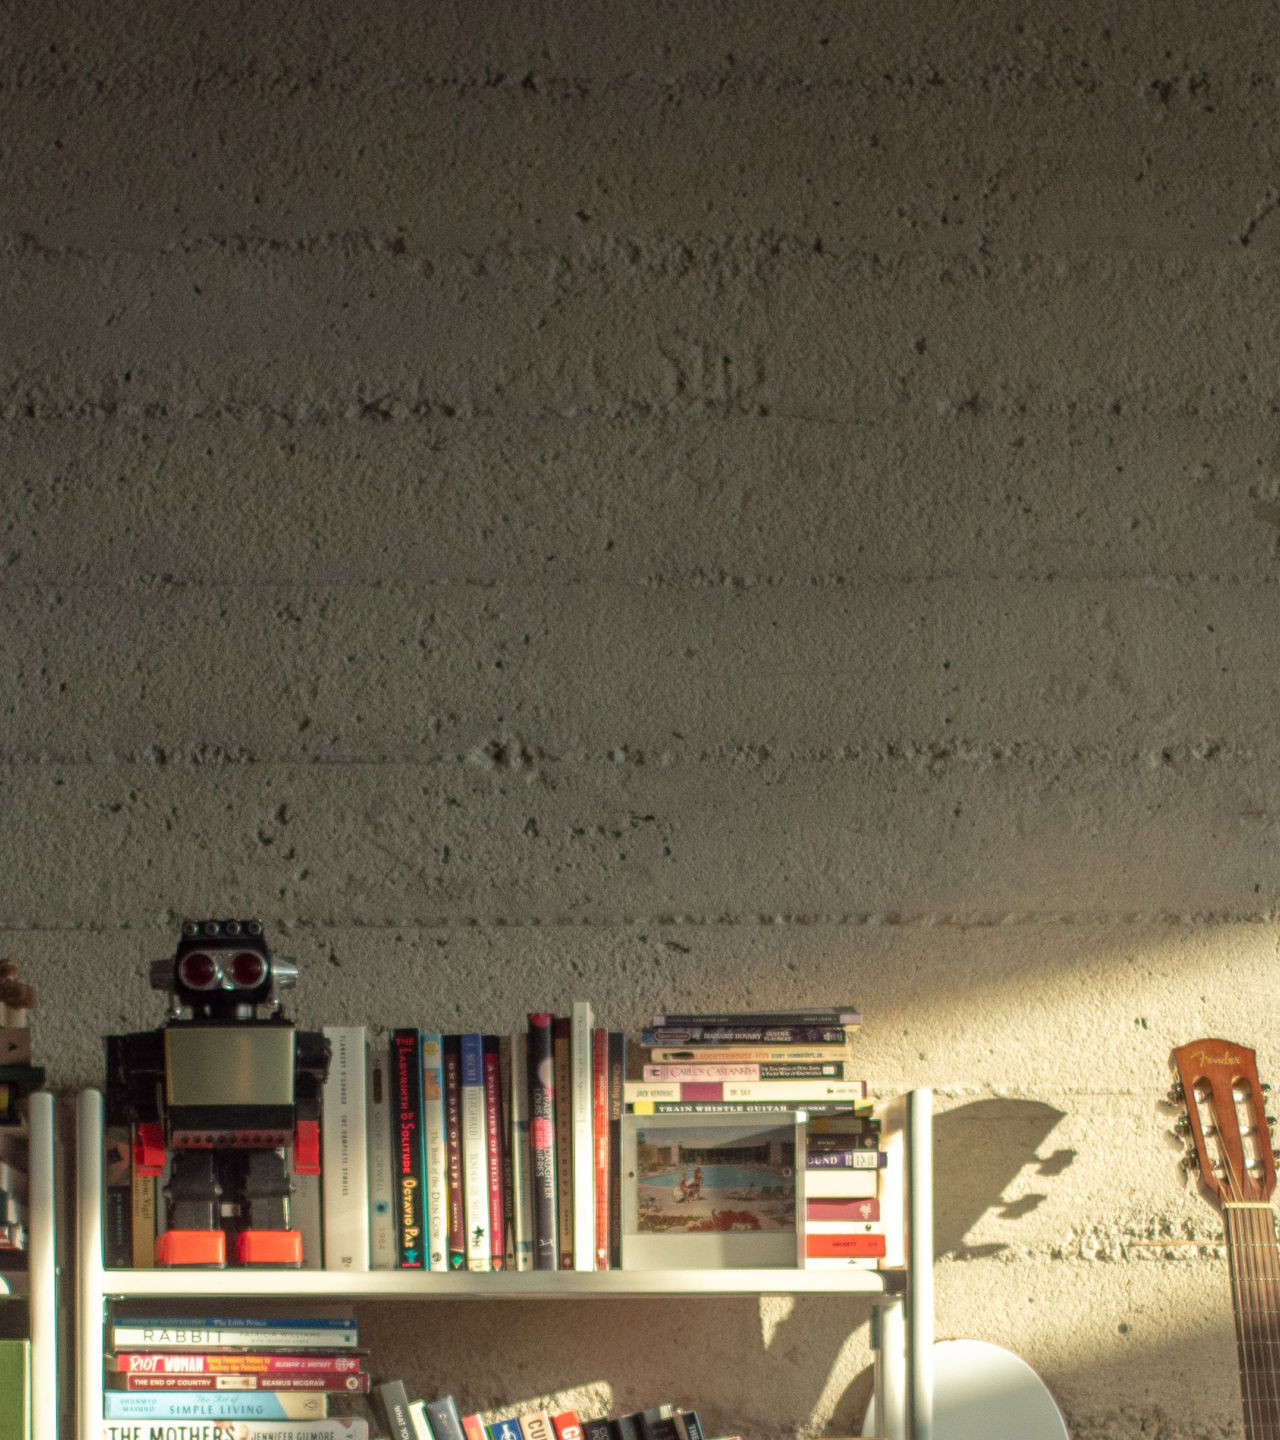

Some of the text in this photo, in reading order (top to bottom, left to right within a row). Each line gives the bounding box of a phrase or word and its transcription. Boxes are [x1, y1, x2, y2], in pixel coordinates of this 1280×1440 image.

[450, 1098, 458, 1123] DAY
[658, 1105, 788, 1113] TRAIN WHISTLE GUITAR
[399, 1047, 419, 1248] LABYRINTH SOLITUDE OCTAVIO PAZ
[450, 1131, 458, 1148] OF
[489, 1107, 500, 1192] VIEW OF HILLS
[451, 1156, 459, 1190] LIFE
[544, 1149, 555, 1200] DAUGHTER
[432, 1191, 443, 1213] DUN
[143, 1329, 224, 1344] RABBIT
[129, 1355, 163, 1373] RIOT
[133, 1379, 291, 1387] THE END OF COUNTRY SEAMUS
[169, 1404, 264, 1415] SIMPLE LIVING
